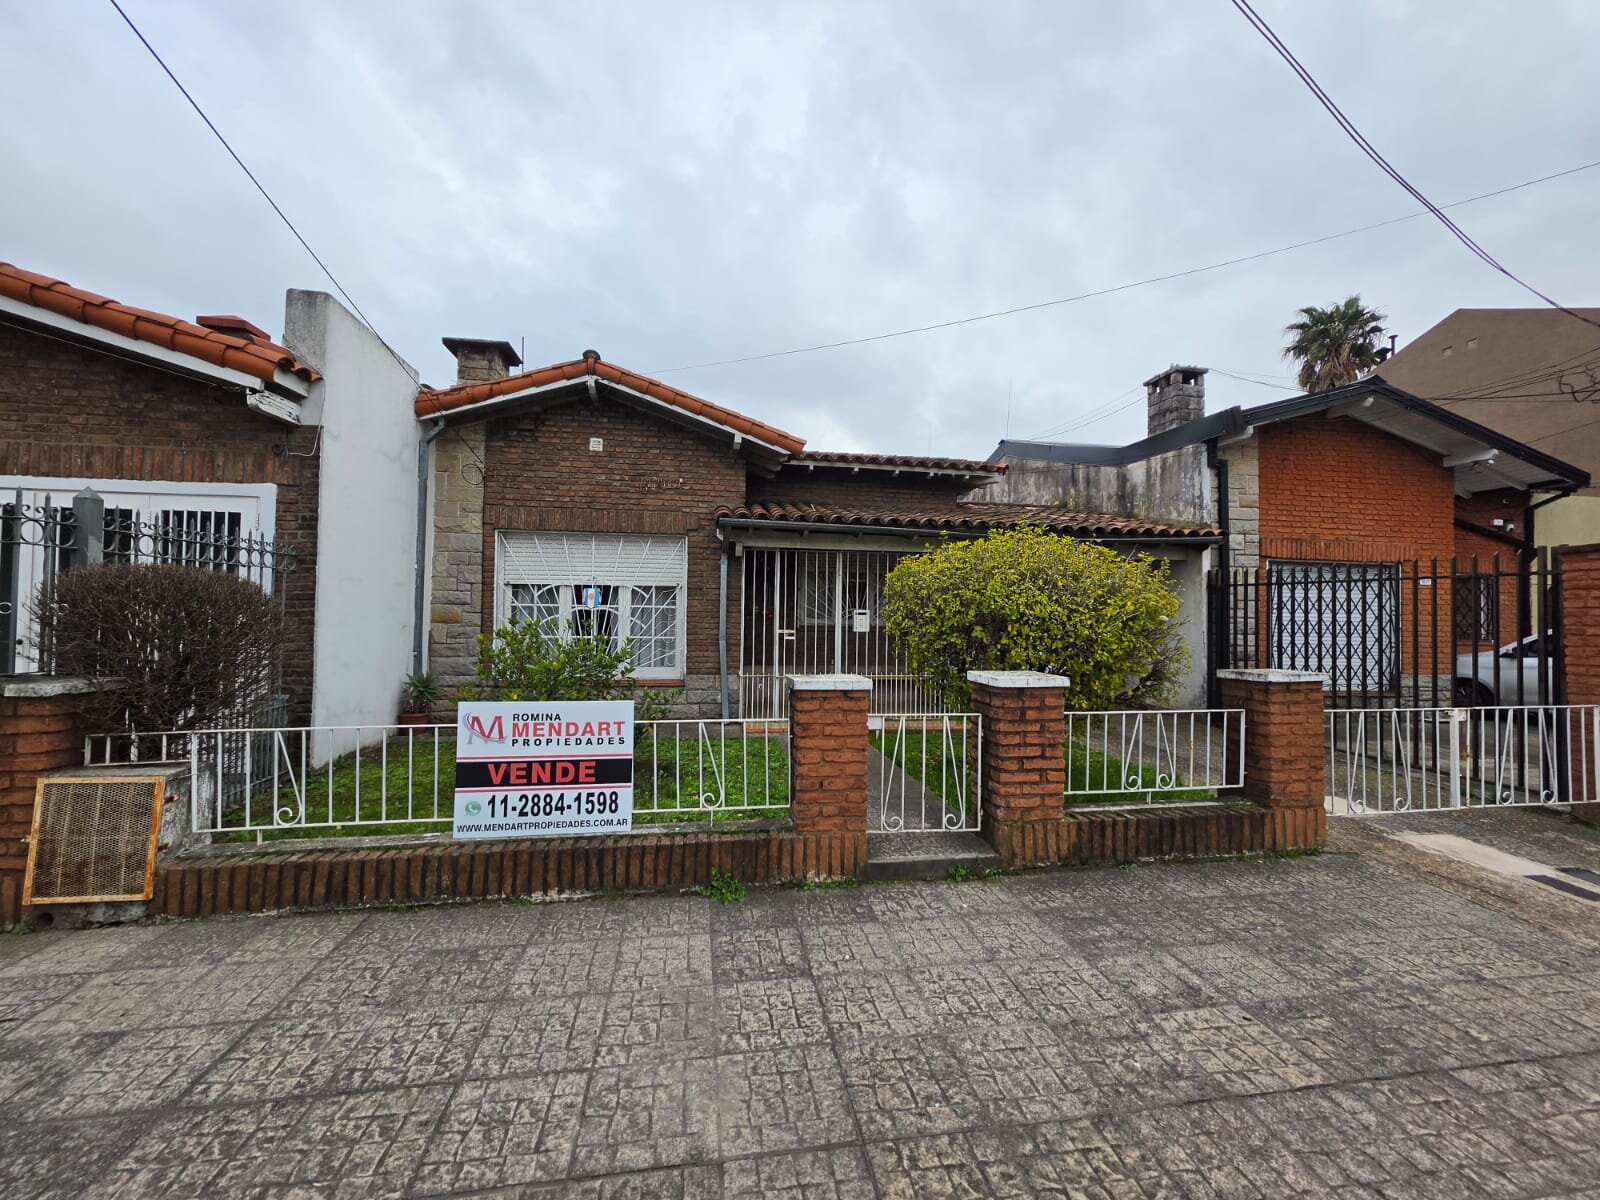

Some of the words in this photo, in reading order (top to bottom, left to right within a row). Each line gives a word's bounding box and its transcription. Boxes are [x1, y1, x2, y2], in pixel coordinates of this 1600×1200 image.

[512, 713, 562, 722] ROMINA
[512, 721, 626, 738] MENDART
[511, 737, 626, 747] PROPIEDADES
[487, 761, 597, 785] VENDE
[487, 791, 619, 818] 11-2884-1598
[457, 818, 628, 833] WWW.MENDARTPROPIEDADES.COM.AR
